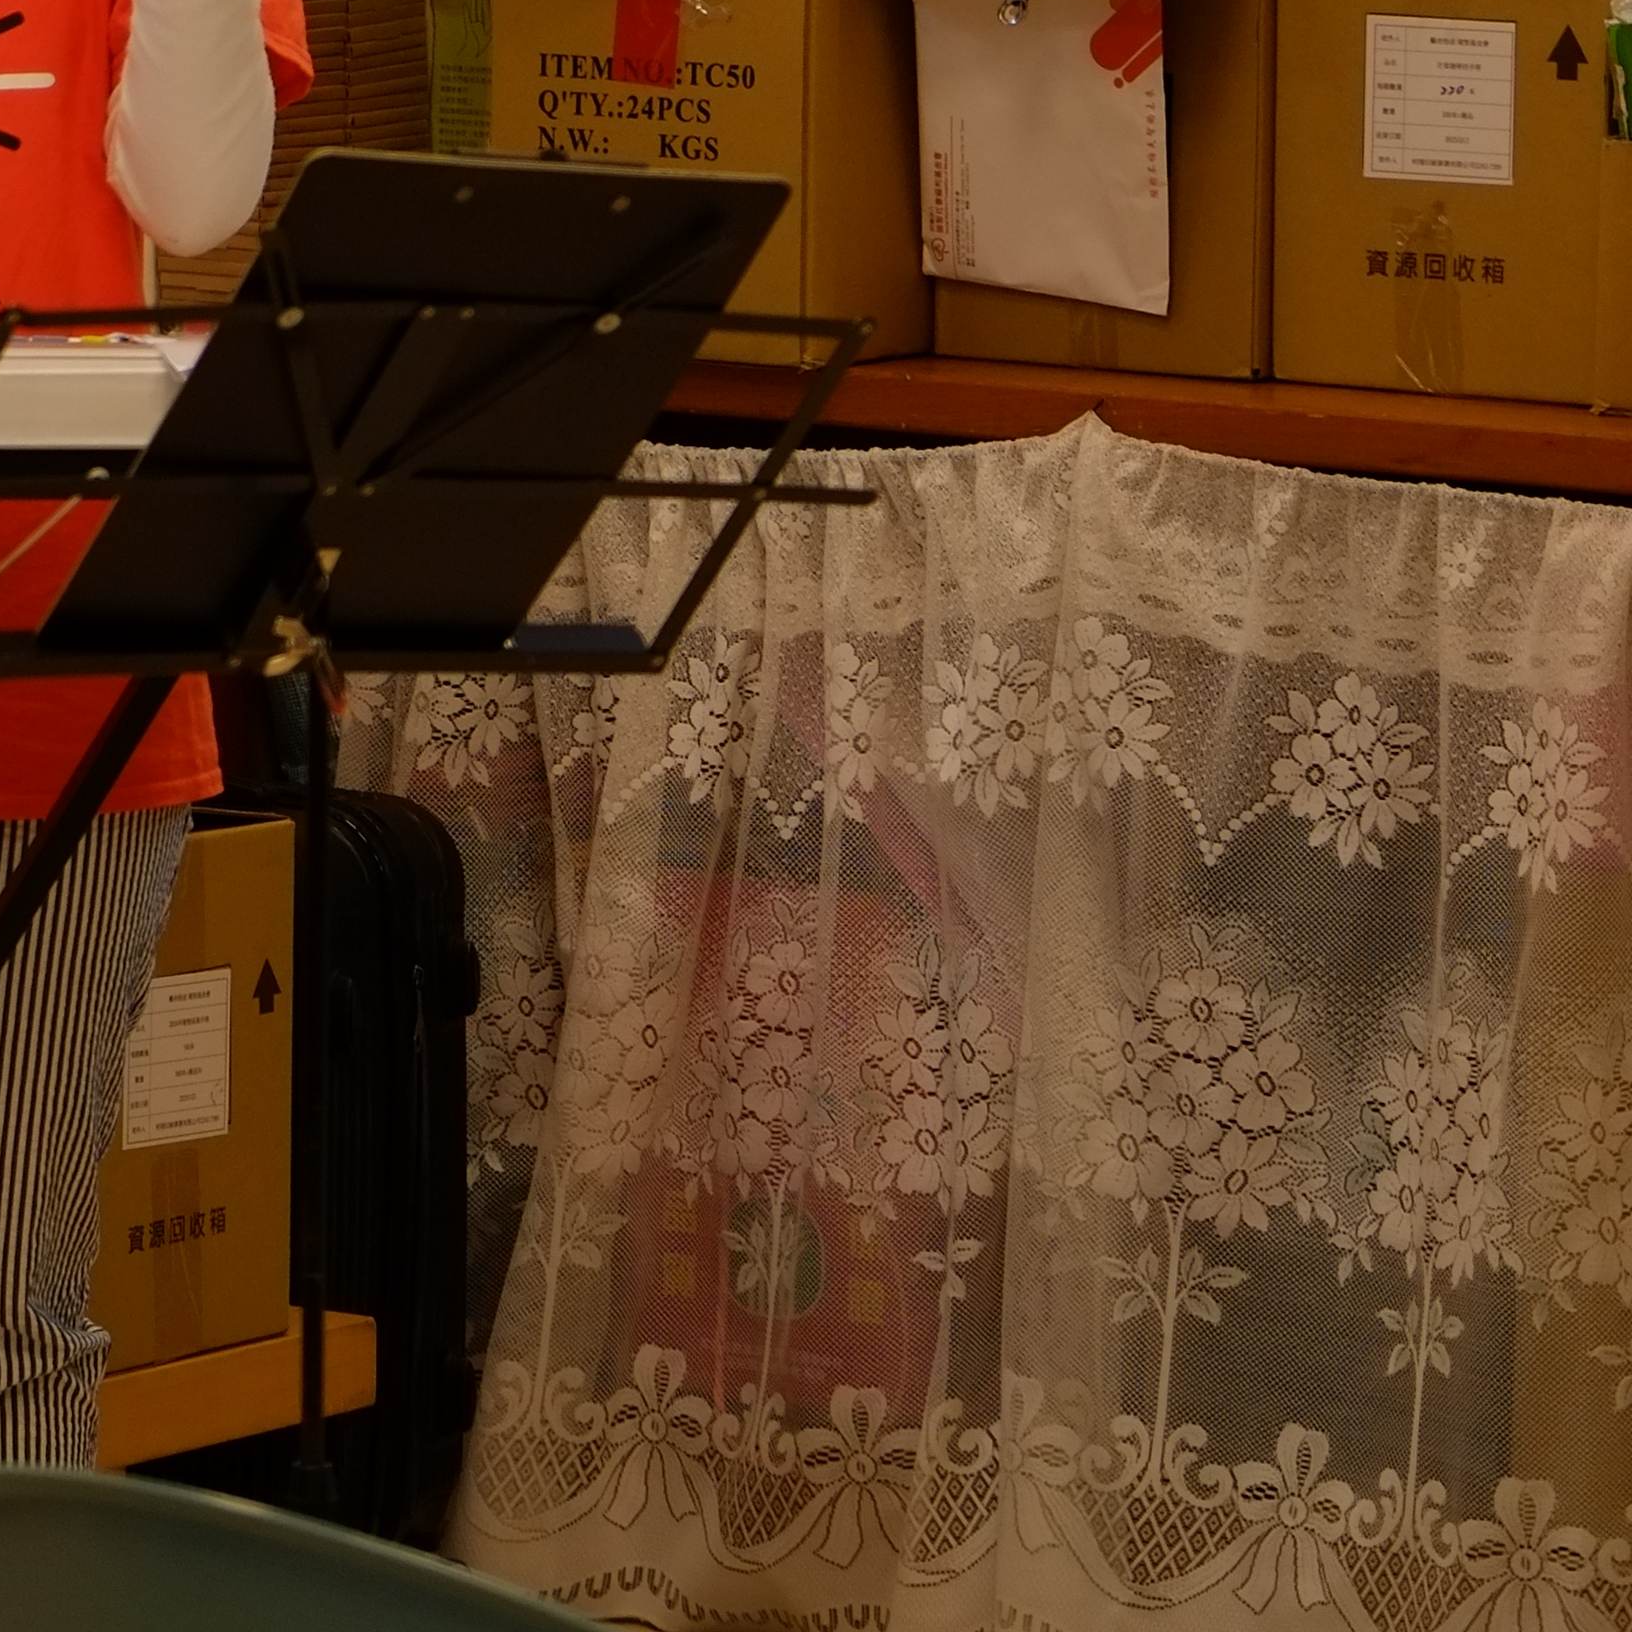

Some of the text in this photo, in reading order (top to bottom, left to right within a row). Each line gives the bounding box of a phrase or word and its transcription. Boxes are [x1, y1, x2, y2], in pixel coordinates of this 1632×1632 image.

[537, 52, 614, 81] ITEM
[658, 133, 720, 162] KGS
[1365, 249, 1507, 285] 資源回收箱
[127, 1205, 228, 1255] 資源回收箱
